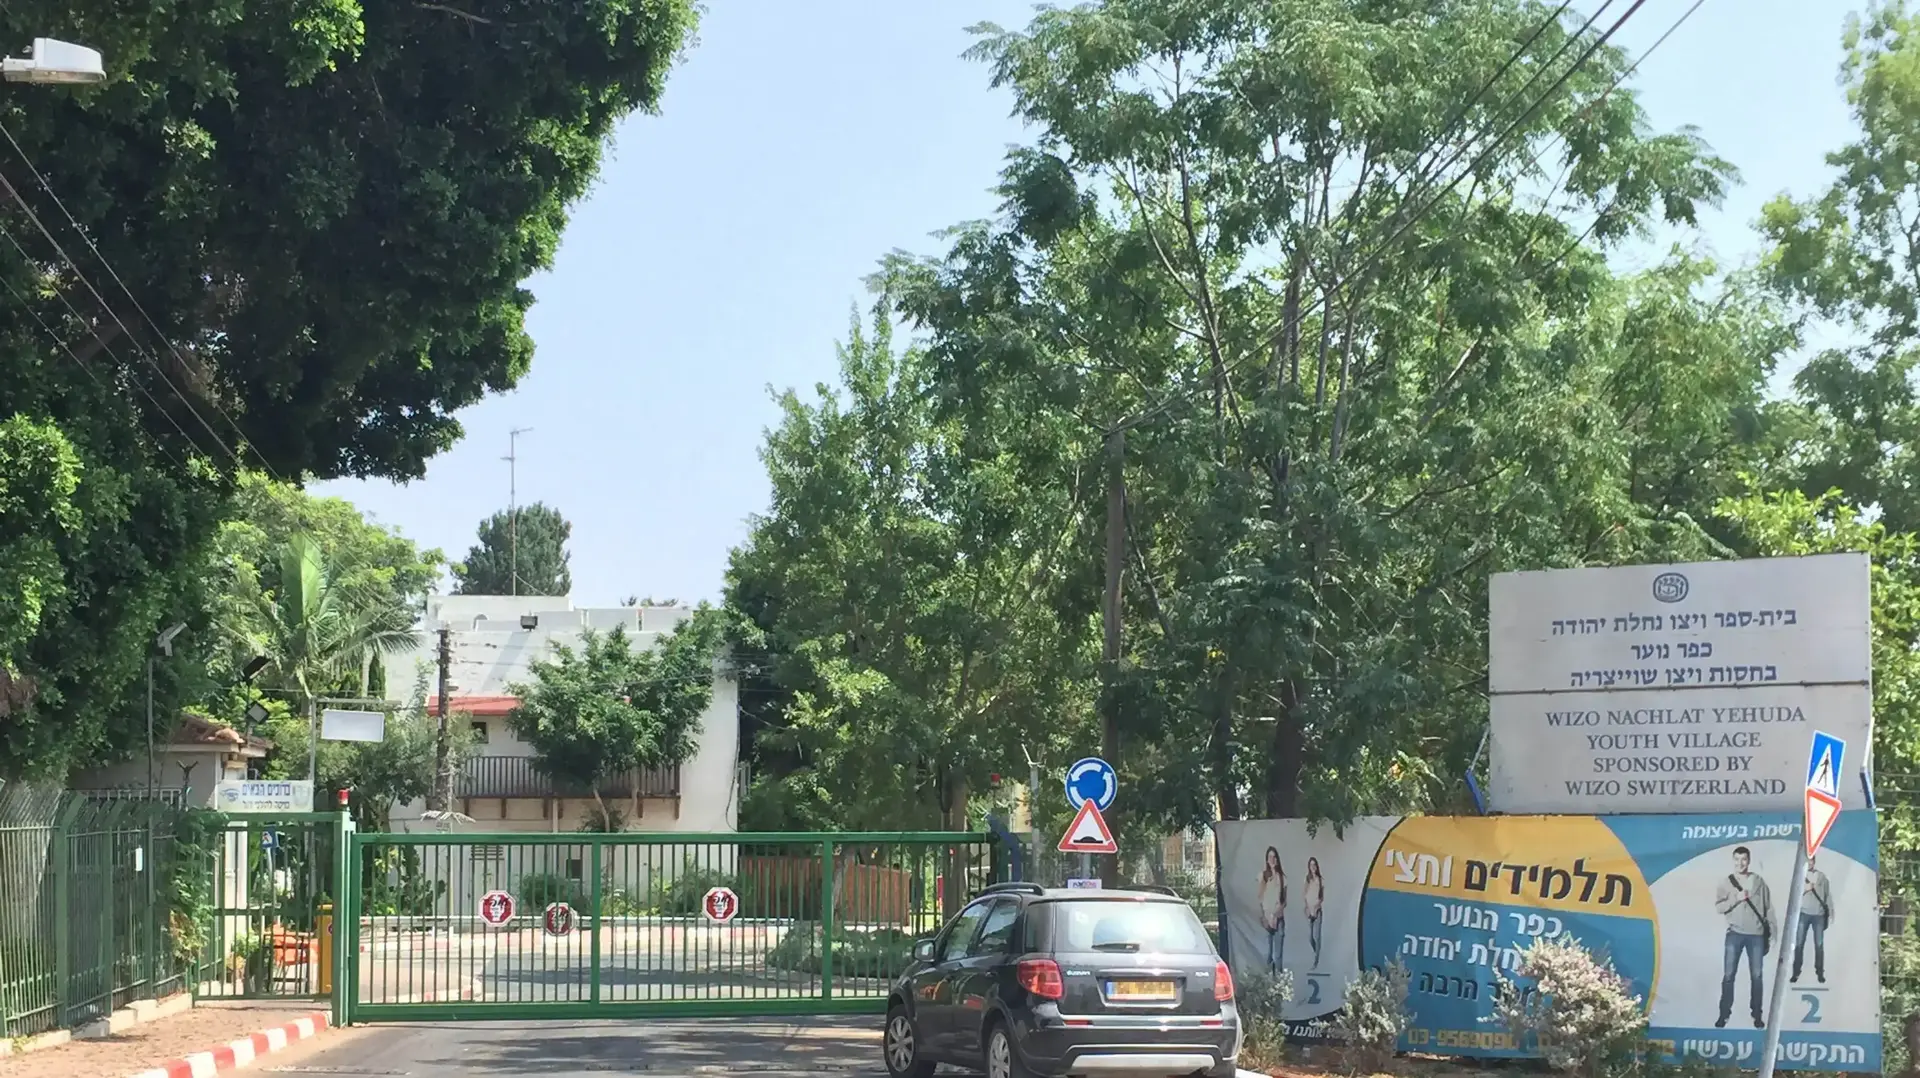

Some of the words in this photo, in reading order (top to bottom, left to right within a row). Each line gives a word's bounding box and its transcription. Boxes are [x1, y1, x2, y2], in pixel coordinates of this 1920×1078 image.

[1552, 618, 1606, 636] יהודה
[1613, 612, 1662, 632] נחלת
[1670, 612, 1707, 631] ויצו
[1714, 608, 1797, 628] בית-ספר
[1631, 643, 1670, 661] נוער
[1677, 641, 1713, 658] כפר
[1570, 668, 1658, 688] שוייצריה
[1665, 667, 1702, 686] ויצו
[1708, 664, 1777, 683] בחסות
[1545, 710, 1600, 727] WIZO
[1607, 707, 1705, 725] NACHLAT
[1711, 706, 1806, 724] YEHUDA
[1586, 734, 1659, 750] YOUTH
[1667, 732, 1761, 749] VILLAGE
[1593, 757, 1720, 773] SPONSORED
[1726, 756, 1753, 772] BY
[1565, 780, 1620, 796] WIZO
[1627, 778, 1786, 796] SWITZERLAND
[1682, 825, 1748, 839] בעיצומה
[1754, 823, 1802, 838] רשמה
[1385, 848, 1453, 888] וחצי
[1464, 857, 1632, 907] תלמידים
[1433, 902, 1499, 931] הנוער
[1509, 912, 1562, 938] כפר
[1402, 934, 1461, 961] יהודה
[1467, 938, 1522, 970] חלת
[1307, 979, 1321, 1004] 2
[1419, 972, 1479, 1001] הרבה
[1800, 994, 1822, 1023] 2
[1683, 1039, 1753, 1060] עכשיו
[1762, 1041, 1865, 1066] התקשר
